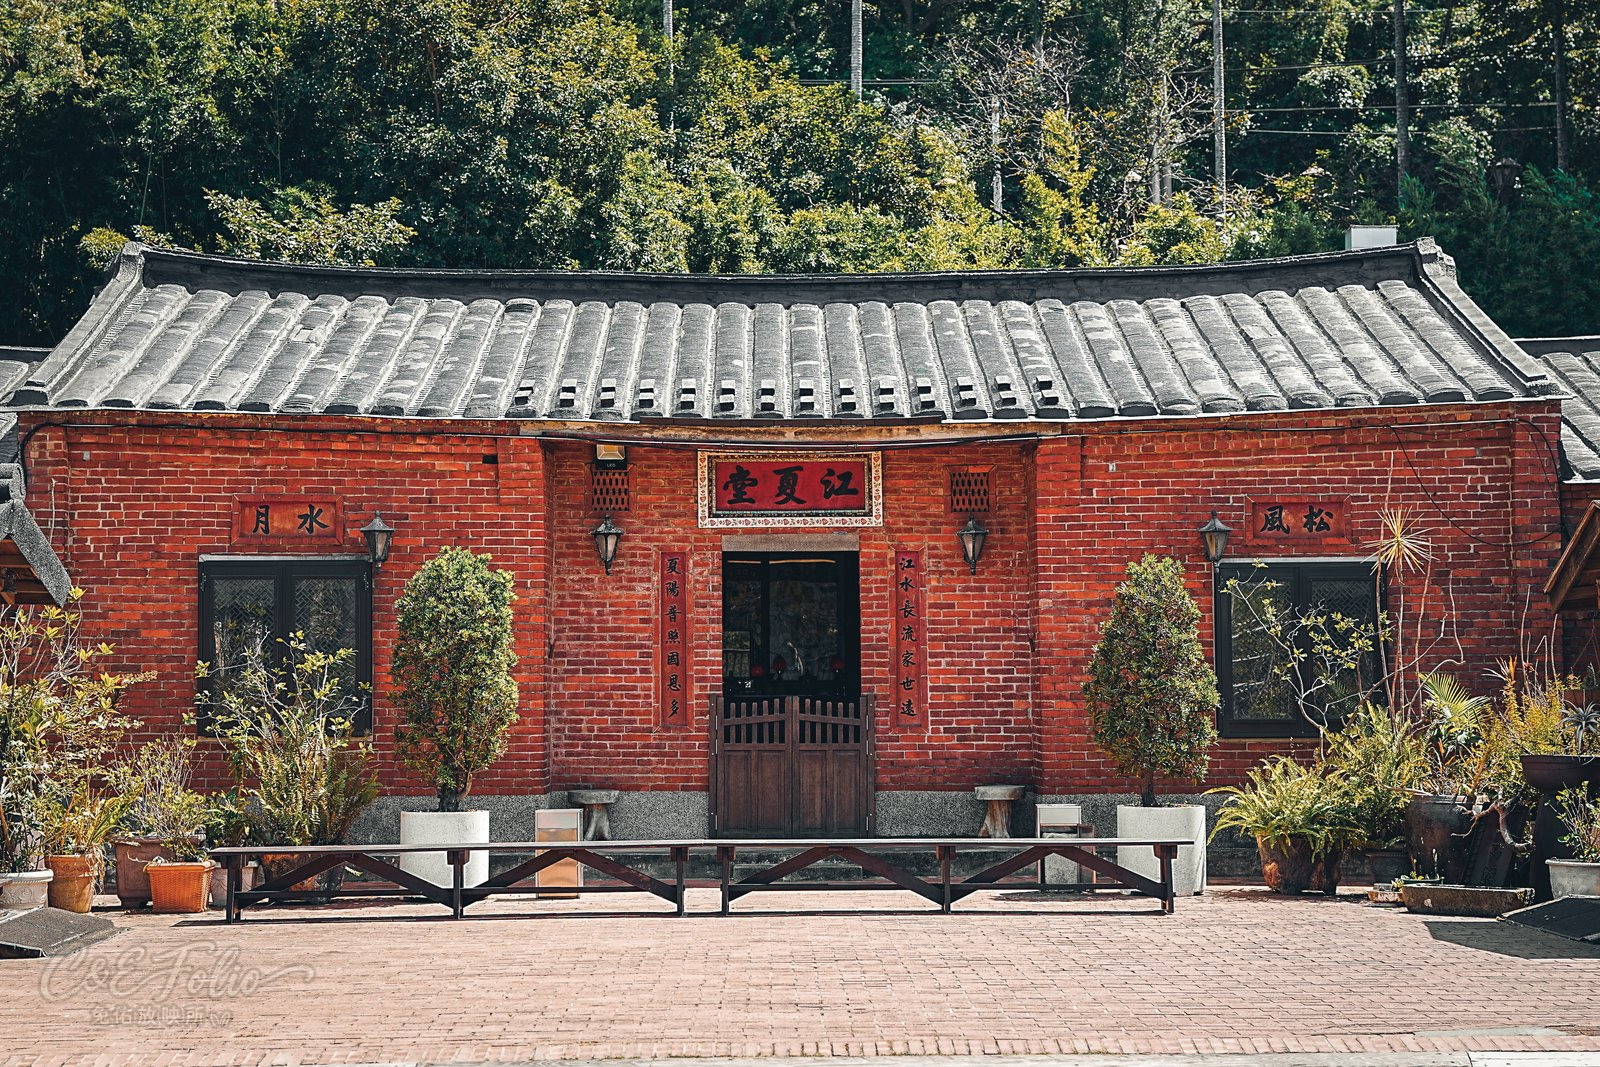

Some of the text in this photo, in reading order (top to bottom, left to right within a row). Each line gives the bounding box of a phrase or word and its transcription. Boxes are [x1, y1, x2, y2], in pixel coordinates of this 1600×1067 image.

[723, 464, 859, 505] 江夏堂
[252, 503, 330, 535] 水月
[1260, 504, 1334, 535] 松風
[899, 557, 917, 717] 江水長流家世遠
